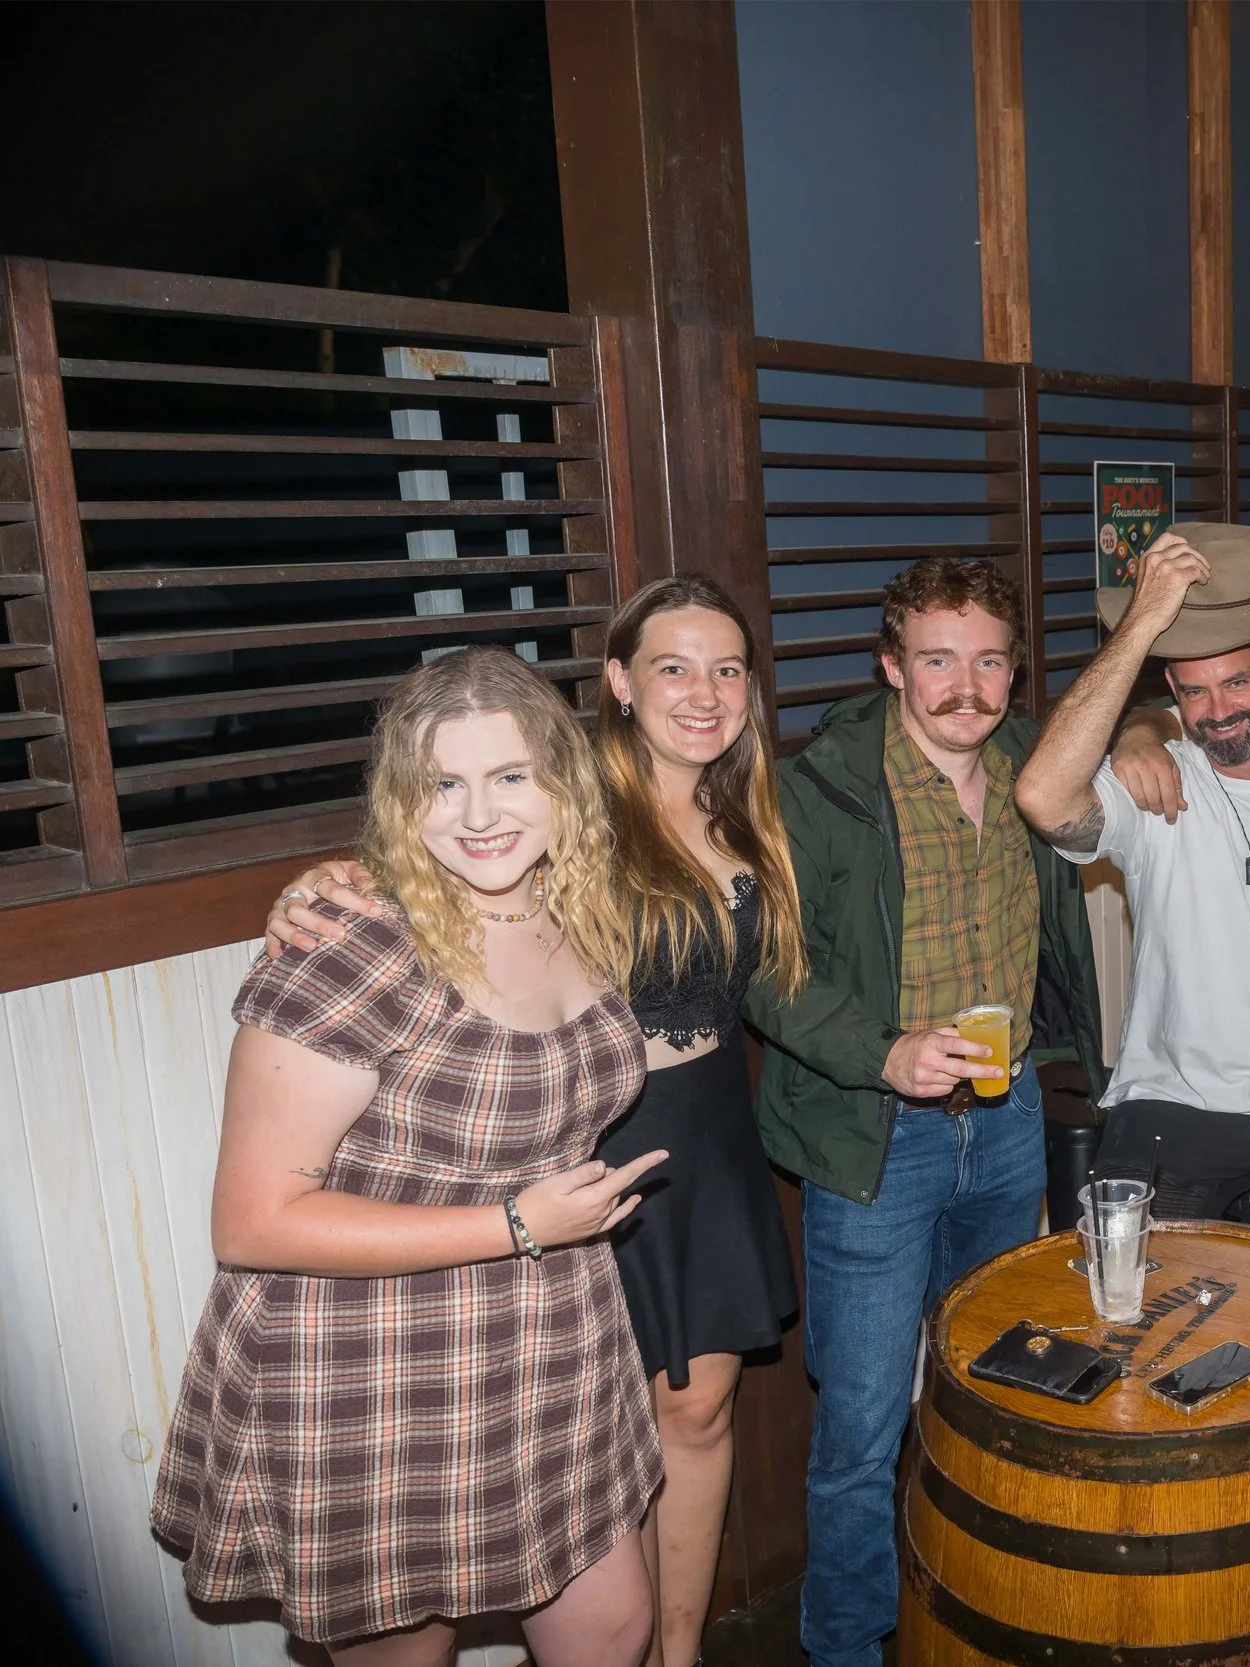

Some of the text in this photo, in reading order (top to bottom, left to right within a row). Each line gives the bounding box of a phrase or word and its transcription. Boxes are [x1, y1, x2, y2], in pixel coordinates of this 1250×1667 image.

[1102, 484, 1169, 515] POOL
[1111, 502, 1161, 518] Tournament
[1102, 538, 1115, 549] $10
